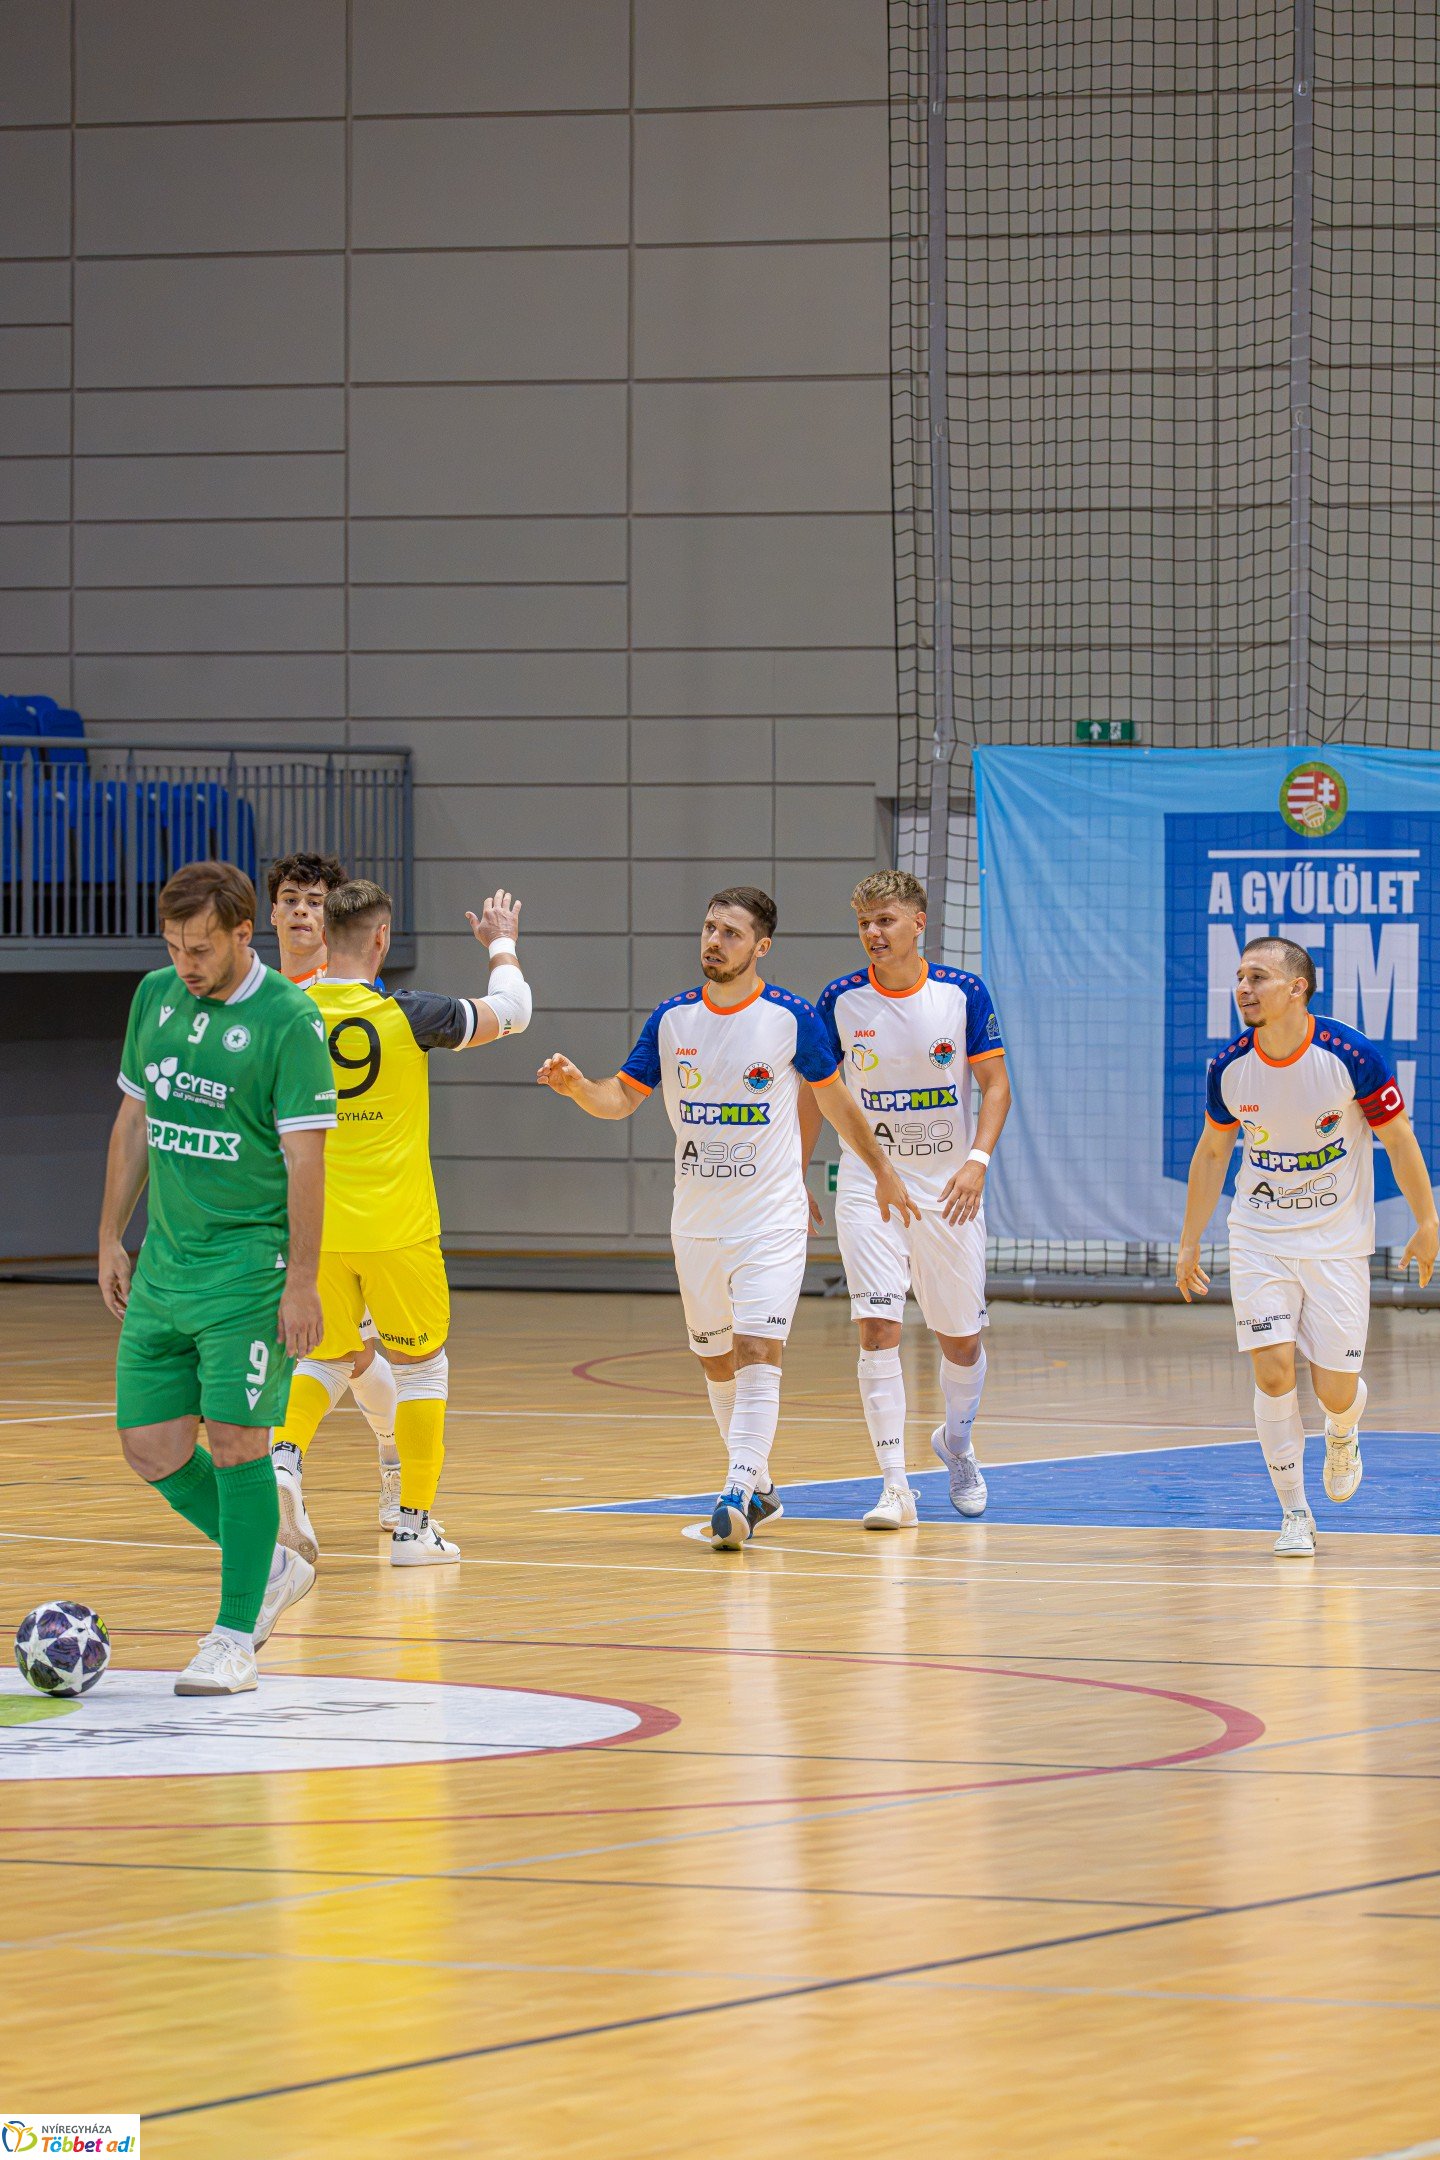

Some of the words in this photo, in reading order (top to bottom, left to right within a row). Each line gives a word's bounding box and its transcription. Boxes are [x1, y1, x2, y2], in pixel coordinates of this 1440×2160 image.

[1208, 872, 1234, 914] A
[1242, 862, 1420, 914] GYŰLÖLET
[188, 1011, 210, 1045] 9
[854, 1030, 876, 1038] JAKO
[328, 1017, 382, 1100] 9
[675, 1047, 697, 1056] JAKO
[175, 1071, 228, 1101] CYEB
[1239, 1104, 1259, 1113] JAKO
[337, 1111, 384, 1122] GYHÁZA
[879, 1141, 953, 1156] TUDIO
[681, 1163, 757, 1178] STUDIO
[1249, 1193, 1338, 1209] STUDIO
[359, 1319, 372, 1328] AKO
[767, 1316, 787, 1325] JAKO
[378, 1330, 416, 1346] NSHINE
[246, 1340, 269, 1385] 9
[876, 1437, 900, 1447] JAKO
[732, 1463, 757, 1476] JAKO
